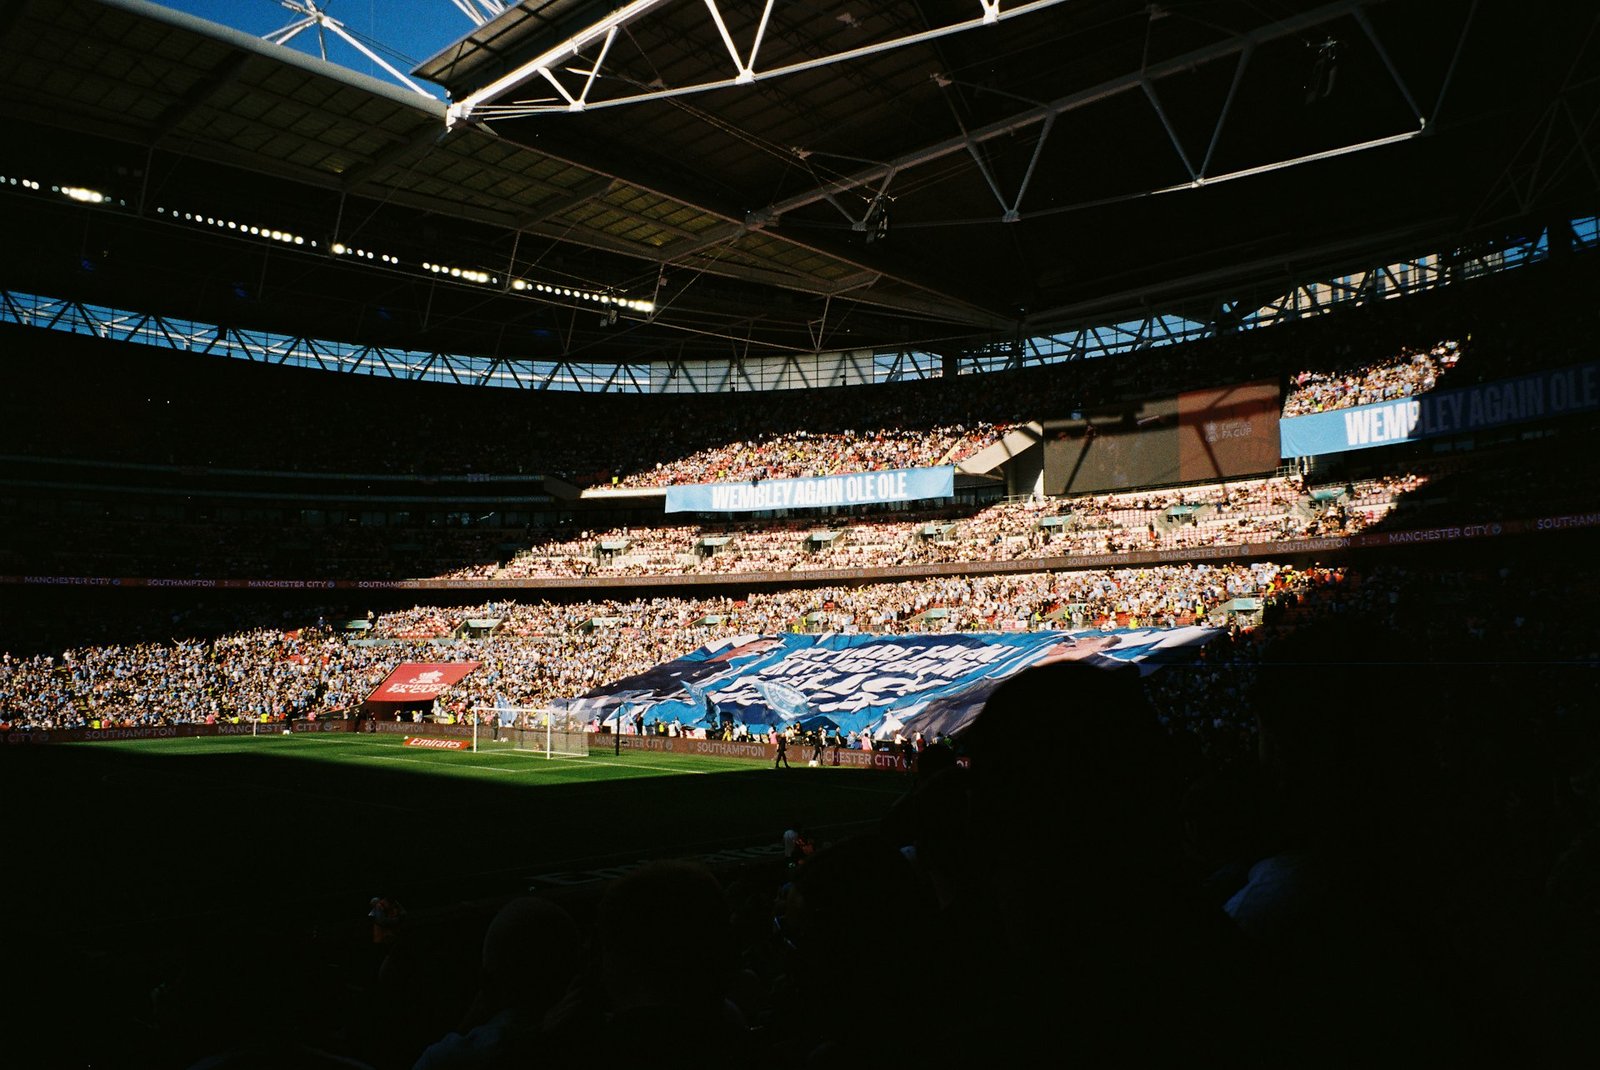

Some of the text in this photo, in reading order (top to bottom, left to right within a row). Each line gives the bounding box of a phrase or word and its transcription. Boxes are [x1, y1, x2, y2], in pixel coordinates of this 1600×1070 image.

[1344, 366, 1599, 446] WEMBLEY AGAIN OLE
[711, 472, 908, 510] WEMBLEY AGAIN OLE OLE
[1536, 513, 1600, 530] SOUTHAM
[1388, 527, 1462, 543] MANCHESTER
[1463, 524, 1489, 537] CITY
[1276, 538, 1350, 551] SOUTHAMPTON
[1159, 545, 1239, 559] MANCHESTER CITY
[1067, 555, 1130, 566] SOUTHAMPTON
[24, 576, 88, 585] MANCHESTER
[89, 577, 111, 585] CITY
[147, 579, 216, 588] SOUTHAMPTON
[248, 580, 304, 589] MANCHESTER
[306, 580, 327, 588] CITY
[358, 580, 420, 589] SOUTHAMPTON
[447, 581, 498, 589] MANCHESTER
[544, 579, 599, 587] SOUTHAMPTON
[84, 727, 177, 741] SOUTHAMPTON
[218, 721, 292, 734] MANCHESTE
[296, 721, 321, 732] CITY
[7, 733, 33, 744] CITY
[409, 736, 462, 750] Emirates
[646, 737, 665, 750] CITY
[697, 742, 765, 757] SOUTHAMPTON
[874, 753, 901, 767] CITY
